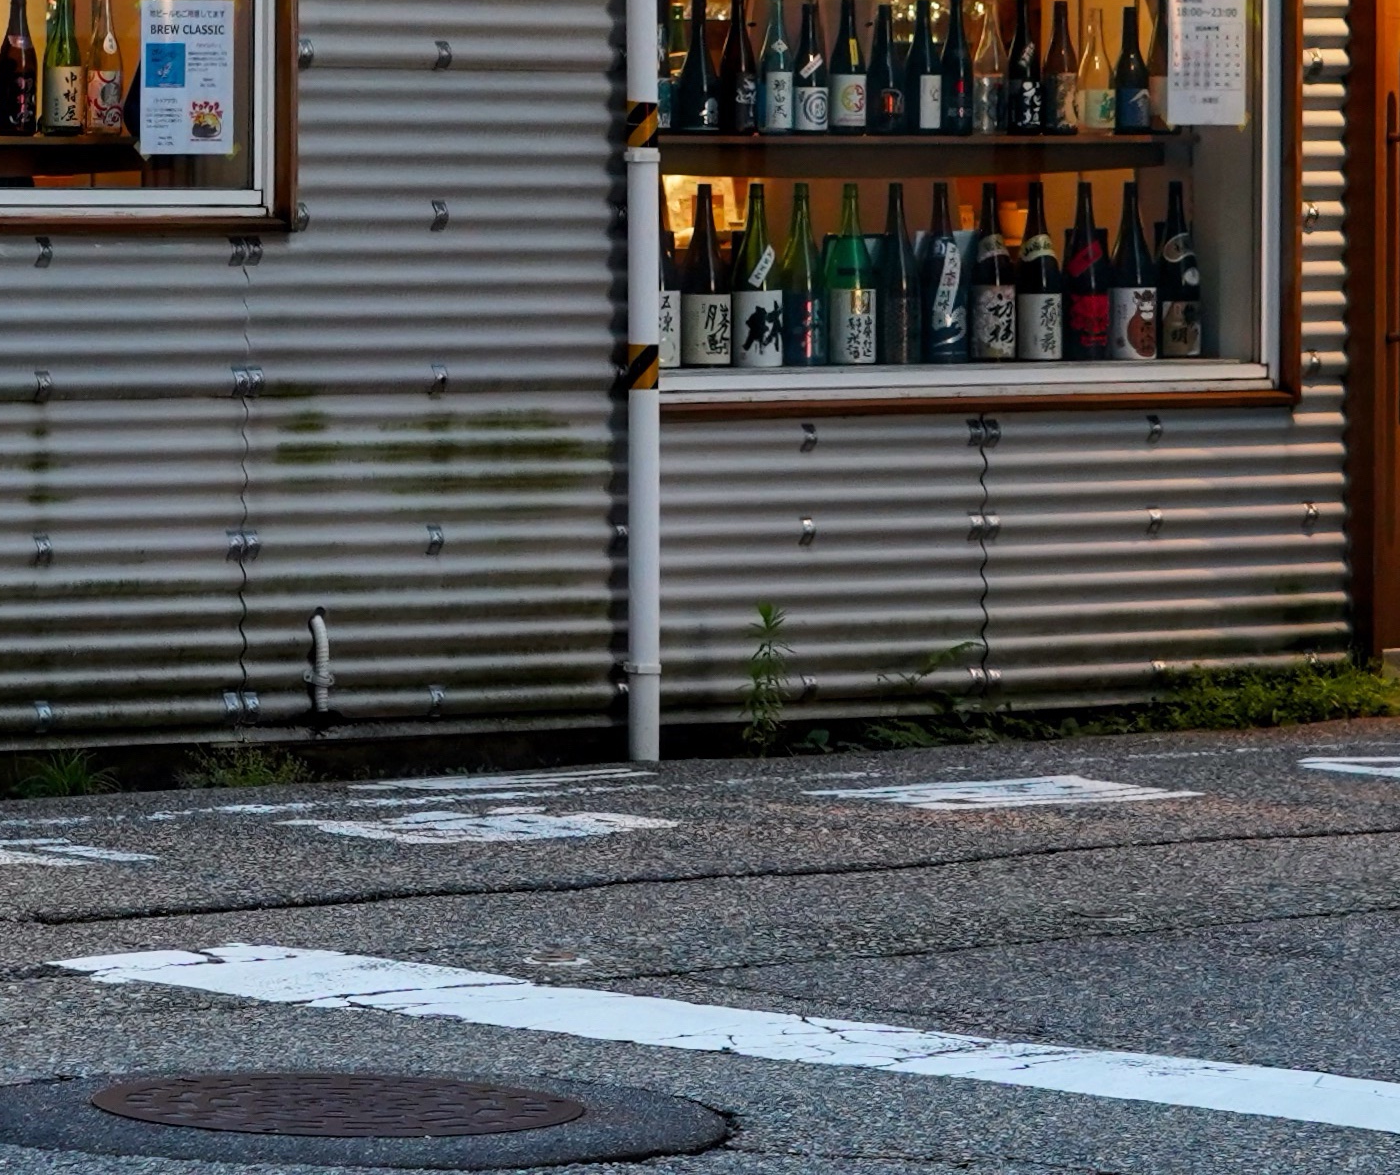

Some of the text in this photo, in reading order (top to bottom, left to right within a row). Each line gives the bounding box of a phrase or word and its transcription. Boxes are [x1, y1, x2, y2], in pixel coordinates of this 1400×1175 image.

[150, 24, 226, 35] BREW CLASSIC
[60, 71, 79, 122] 中村屋
